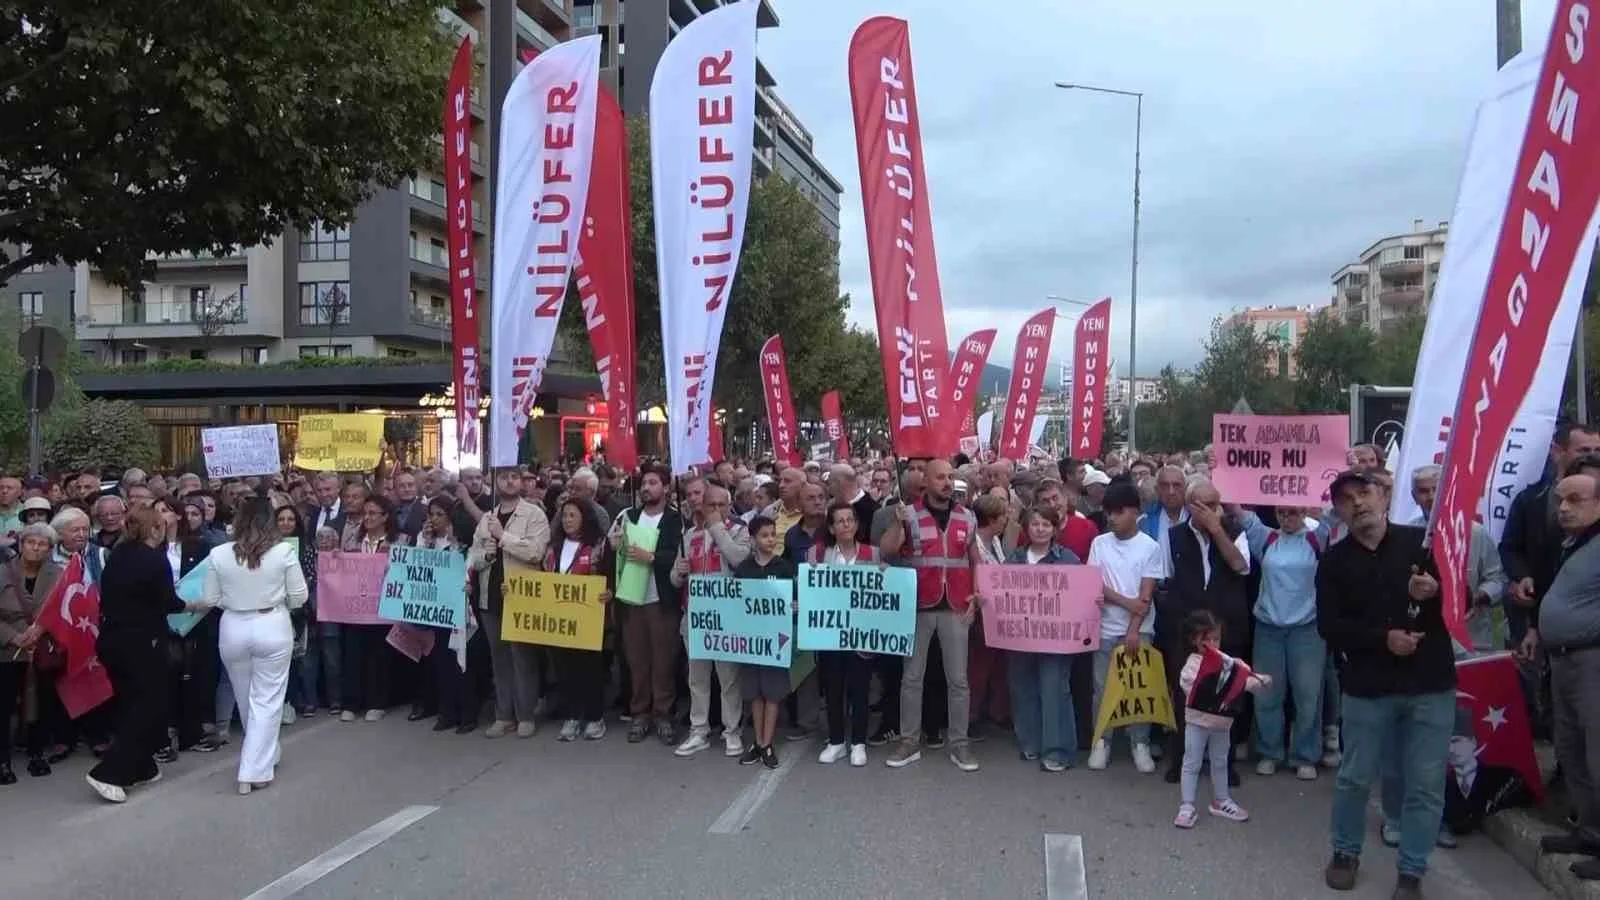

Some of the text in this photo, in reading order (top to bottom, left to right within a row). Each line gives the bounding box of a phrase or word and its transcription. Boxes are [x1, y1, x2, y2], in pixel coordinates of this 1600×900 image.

[690, 50, 735, 312] NİLÜFER
[880, 56, 918, 301] NİLÜFER
[527, 80, 579, 318] NİLÜFER
[1083, 316, 1105, 331] YENİ
[1009, 347, 1039, 448] MUDANYA
[1080, 342, 1098, 449] MUDANYA
[771, 373, 790, 453] MUDANY
[1220, 424, 1321, 444] TEK ADAMLA
[1260, 475, 1309, 497] GEÇER
[1493, 427, 1527, 522] PARTİ
[391, 545, 408, 564] SİZ
[385, 580, 405, 599] BİZ
[509, 576, 587, 602] YİNE YENİ
[689, 577, 743, 600] GENÇLİĞE
[808, 566, 884, 590] ETİKETLER
[745, 598, 786, 616] SABIR
[850, 589, 900, 611] BİZDEN
[512, 611, 577, 636] YENİDEN
[690, 610, 723, 631] DEĞİL
[808, 610, 850, 628] HIZLI
